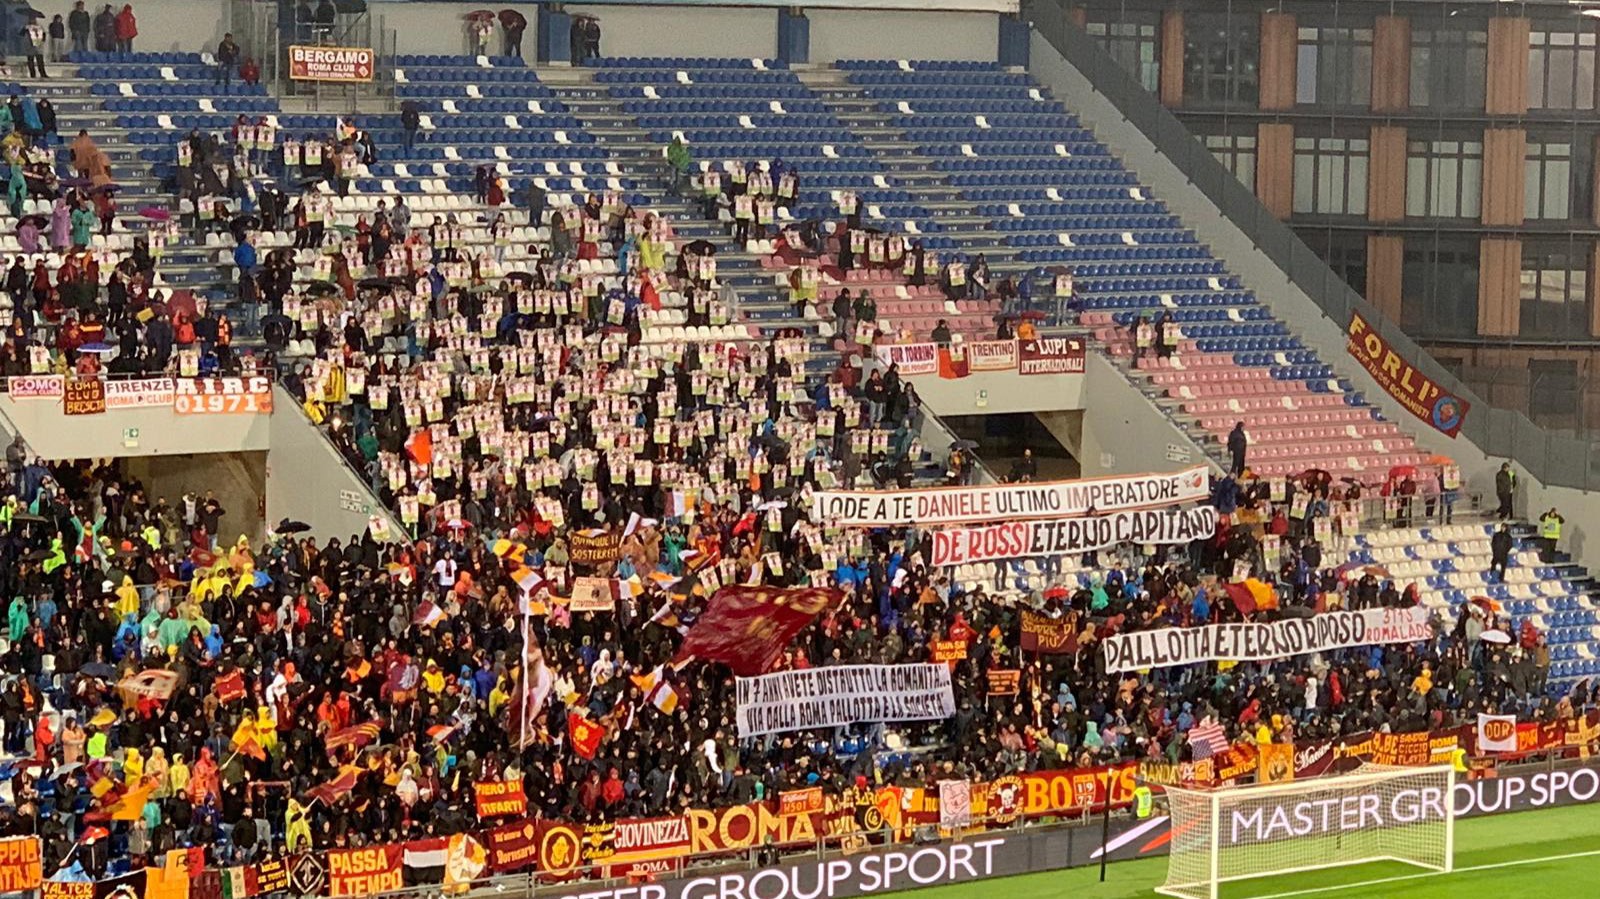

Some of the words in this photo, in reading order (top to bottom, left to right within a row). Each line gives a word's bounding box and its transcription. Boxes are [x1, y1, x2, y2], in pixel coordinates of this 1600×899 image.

[294, 49, 369, 65] BERGAMO
[307, 63, 331, 72] ROMA
[332, 63, 355, 72] CLUB
[971, 341, 1014, 357] TRENTINO
[1036, 338, 1068, 355] LUPI
[1021, 357, 1084, 373] INTERNAZIONALI
[13, 379, 60, 390] COMO
[66, 381, 99, 391] ROMA
[106, 380, 173, 394] FIRENZE
[68, 390, 100, 401] CLUB
[106, 397, 135, 406] ROMA
[147, 393, 173, 404] CLUB
[820, 497, 869, 519] LODE
[873, 498, 888, 519] A
[891, 497, 914, 519] TE
[917, 493, 992, 517] DANIELE
[995, 489, 1061, 513] ULTIMO
[1066, 477, 1180, 510] IMPERATORE
[933, 530, 965, 563] DE
[967, 523, 1031, 558] ROSSI
[1030, 517, 1112, 553] ETERNO
[1115, 507, 1215, 543] CAPITANO
[1213, 620, 1303, 659] ETERNO
[1302, 612, 1366, 649] RIPOSO
[736, 679, 751, 706] IN
[752, 678, 761, 703] 7
[782, 671, 815, 702] AVETE
[817, 666, 876, 697] DISTRUTTO
[873, 666, 889, 692] LA
[746, 706, 765, 733] VIA
[764, 702, 797, 731] DALLA
[799, 698, 829, 727] ROMA
[829, 694, 883, 724] PALLOTTA
[883, 695, 890, 718] E
[891, 693, 906, 718] LA
[1398, 742, 1428, 754] CICCIO
[1429, 735, 1458, 750] ROMA
[475, 783, 505, 796] FIERO
[507, 781, 521, 793] DI
[480, 800, 523, 814] TIFARTI
[1232, 795, 1381, 843] MASTER
[1391, 777, 1527, 823] GROUP
[1529, 766, 1600, 812] SPO
[614, 817, 690, 850] GIOVINEZZA
[689, 803, 817, 857] ROMA
[330, 849, 388, 876] PASSA
[632, 860, 671, 874] ROMA
[681, 859, 854, 899] GROUP
[858, 837, 1006, 894] SPORT
[347, 868, 402, 897] TEMPO
